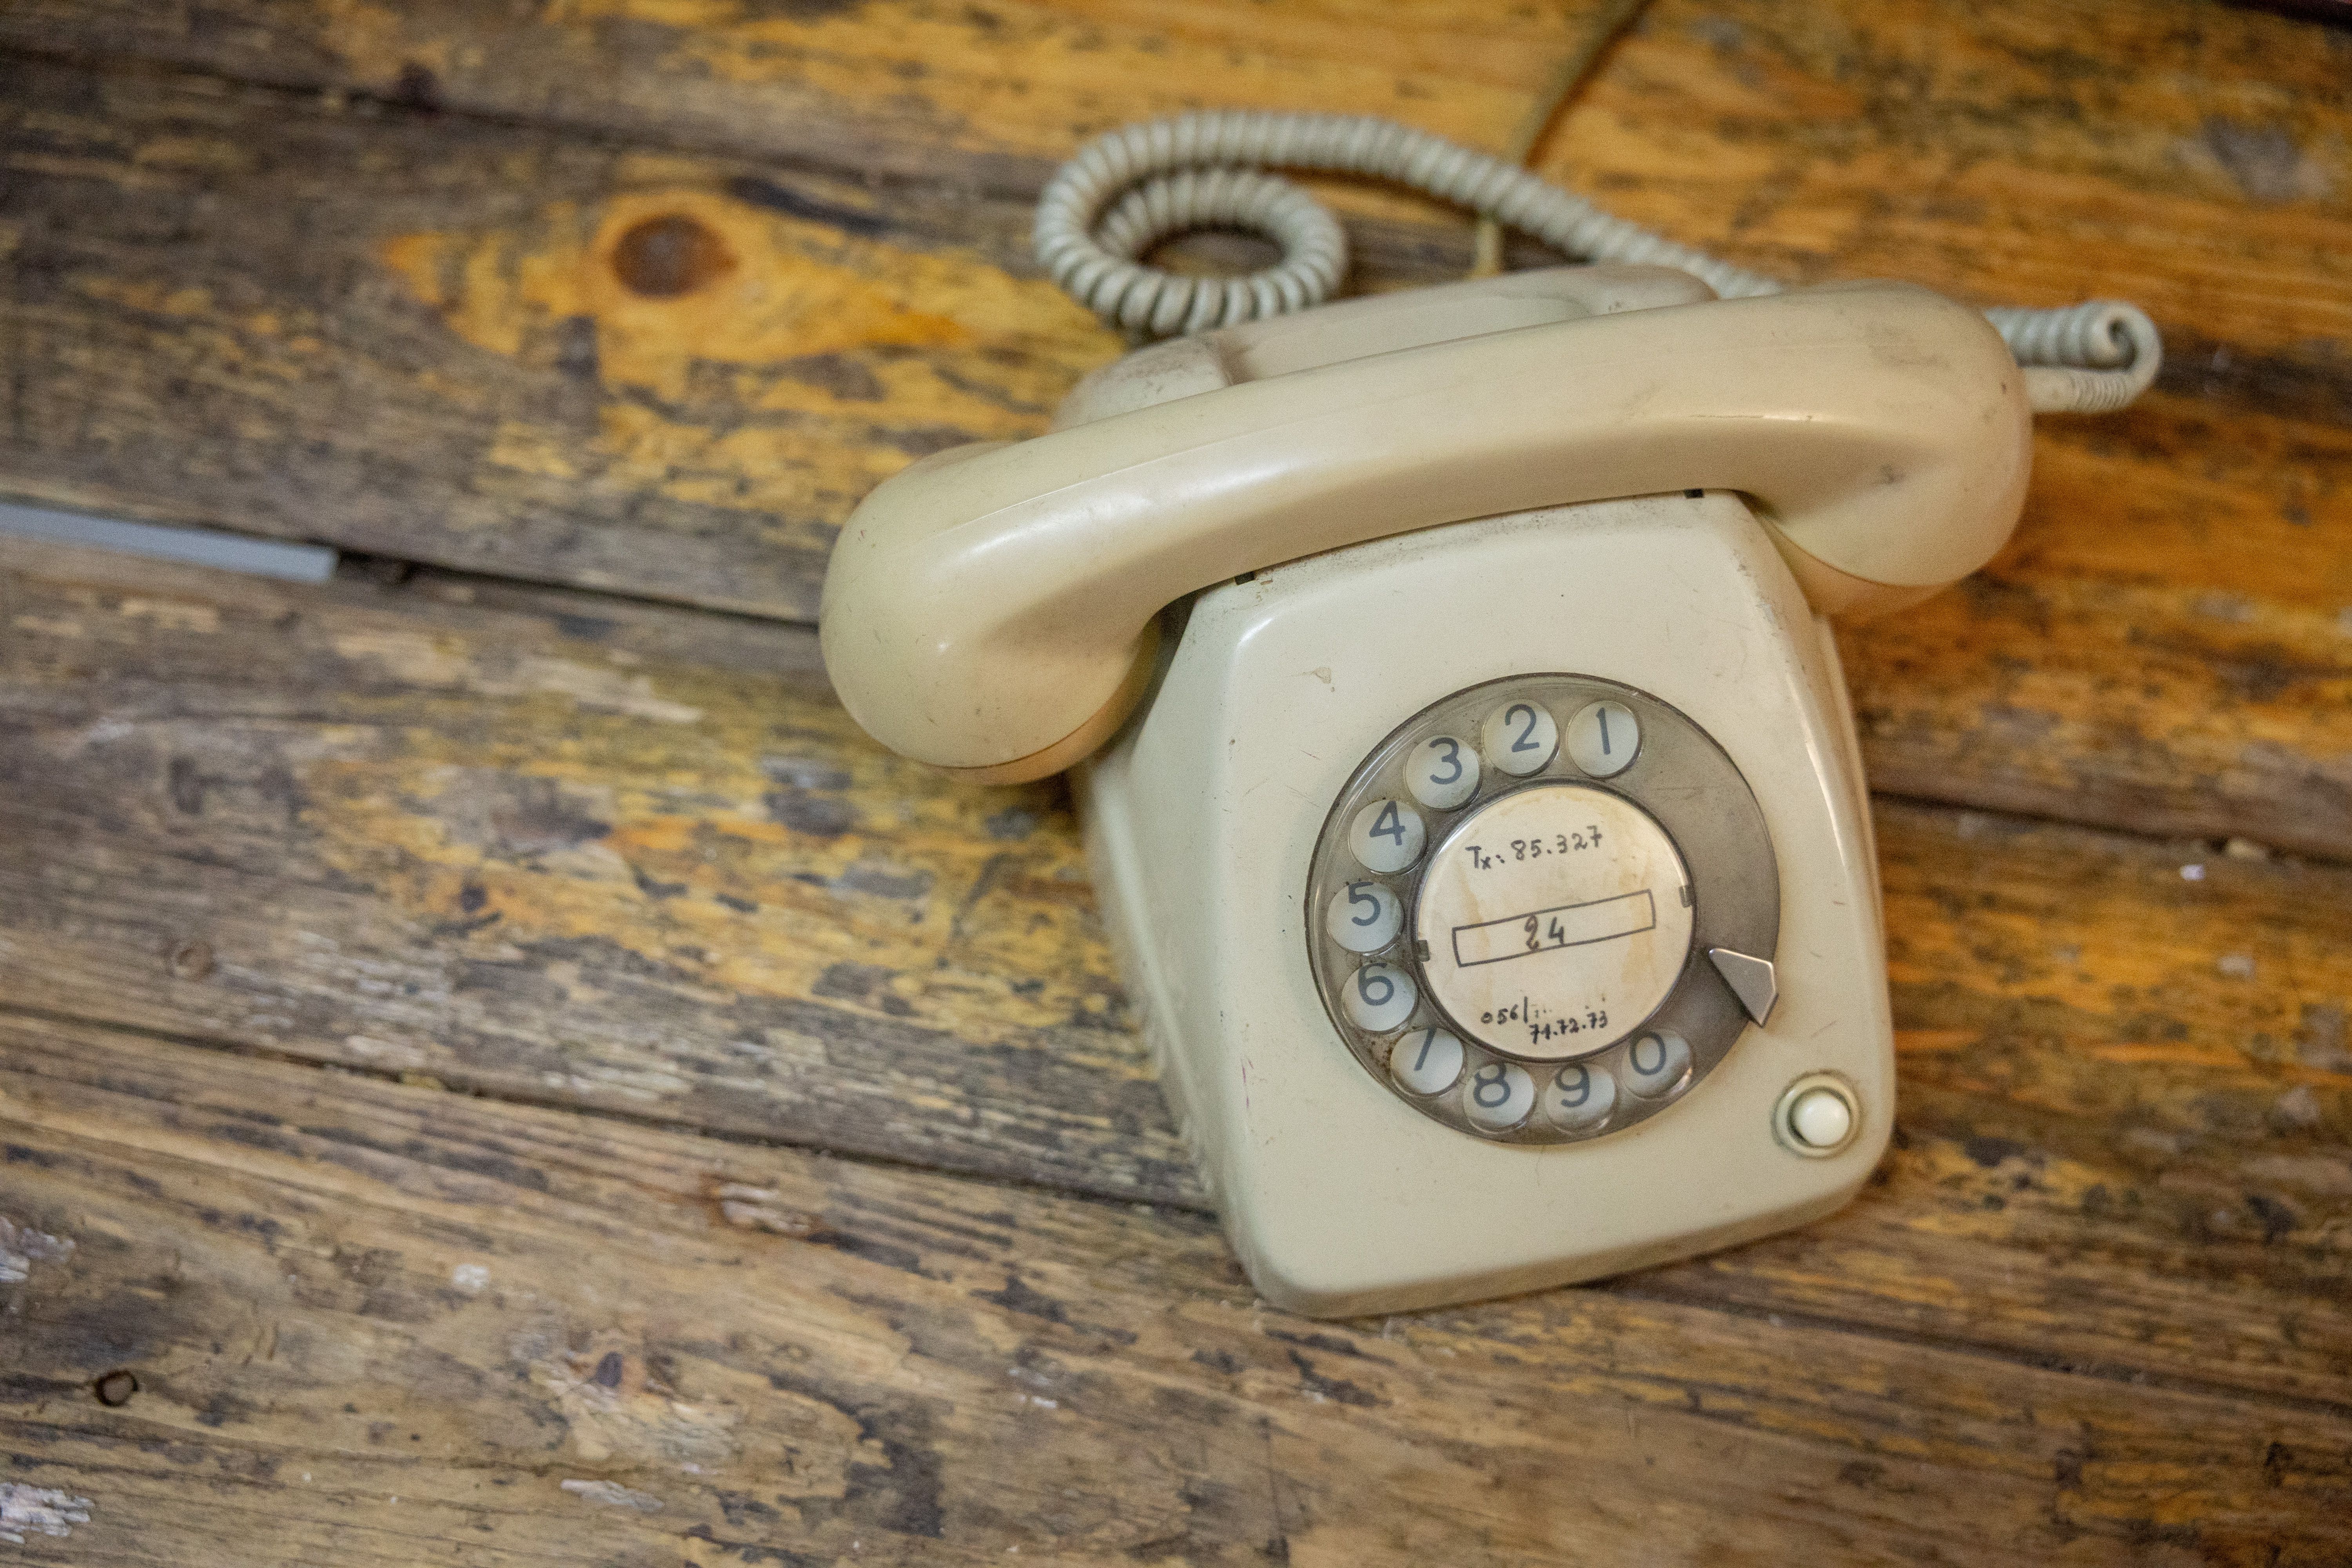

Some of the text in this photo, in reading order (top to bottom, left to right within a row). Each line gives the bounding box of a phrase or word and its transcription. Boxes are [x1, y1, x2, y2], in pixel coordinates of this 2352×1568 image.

[1504, 704, 1540, 753] 2
[1595, 708, 1612, 756] 1
[1430, 737, 1463, 784] 3
[1369, 800, 1405, 849] 4
[1511, 826, 1602, 860] 85.327
[1348, 882, 1381, 926] 5
[1524, 915, 1564, 950] 24
[1358, 962, 1394, 1005] 6
[1629, 1032, 1666, 1075] 0
[1474, 1063, 1510, 1107] 8
[1555, 1063, 1590, 1107] 9
